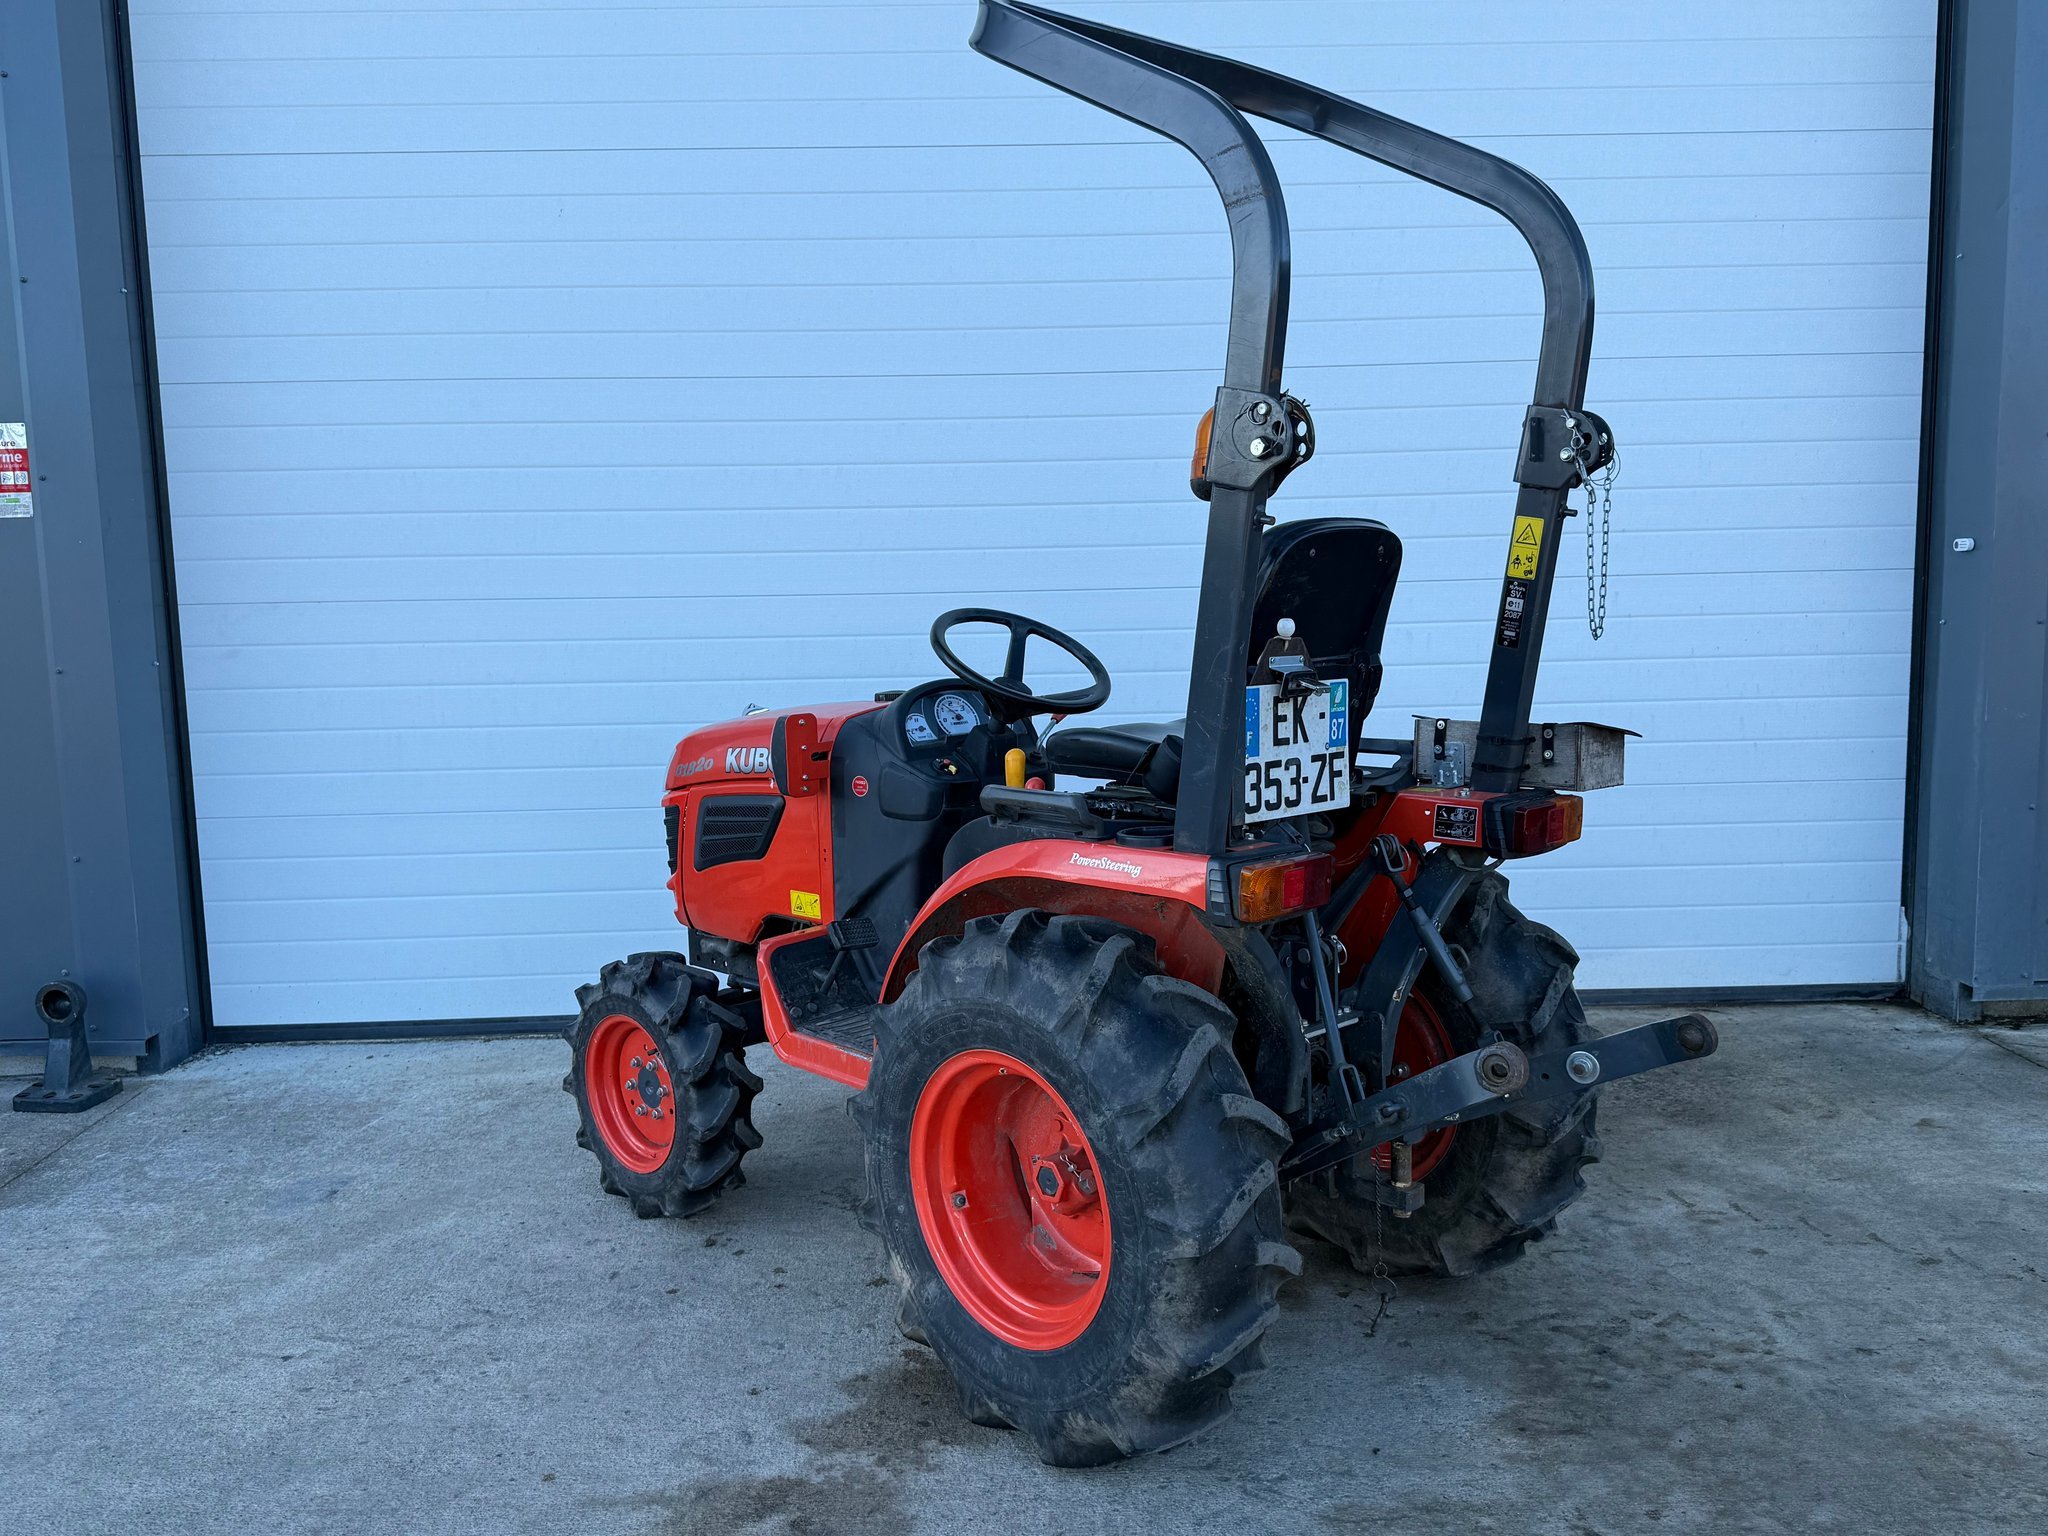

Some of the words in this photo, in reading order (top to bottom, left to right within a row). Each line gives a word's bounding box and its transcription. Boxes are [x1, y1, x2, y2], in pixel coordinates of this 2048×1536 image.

[1504, 610, 1522, 619] 2087
[1247, 732, 1253, 746] F
[1331, 718, 1345, 740] 87
[725, 747, 774, 773] KUB
[1245, 751, 1345, 814] 353-ZF
[1069, 852, 1142, 878] PowerSteering
